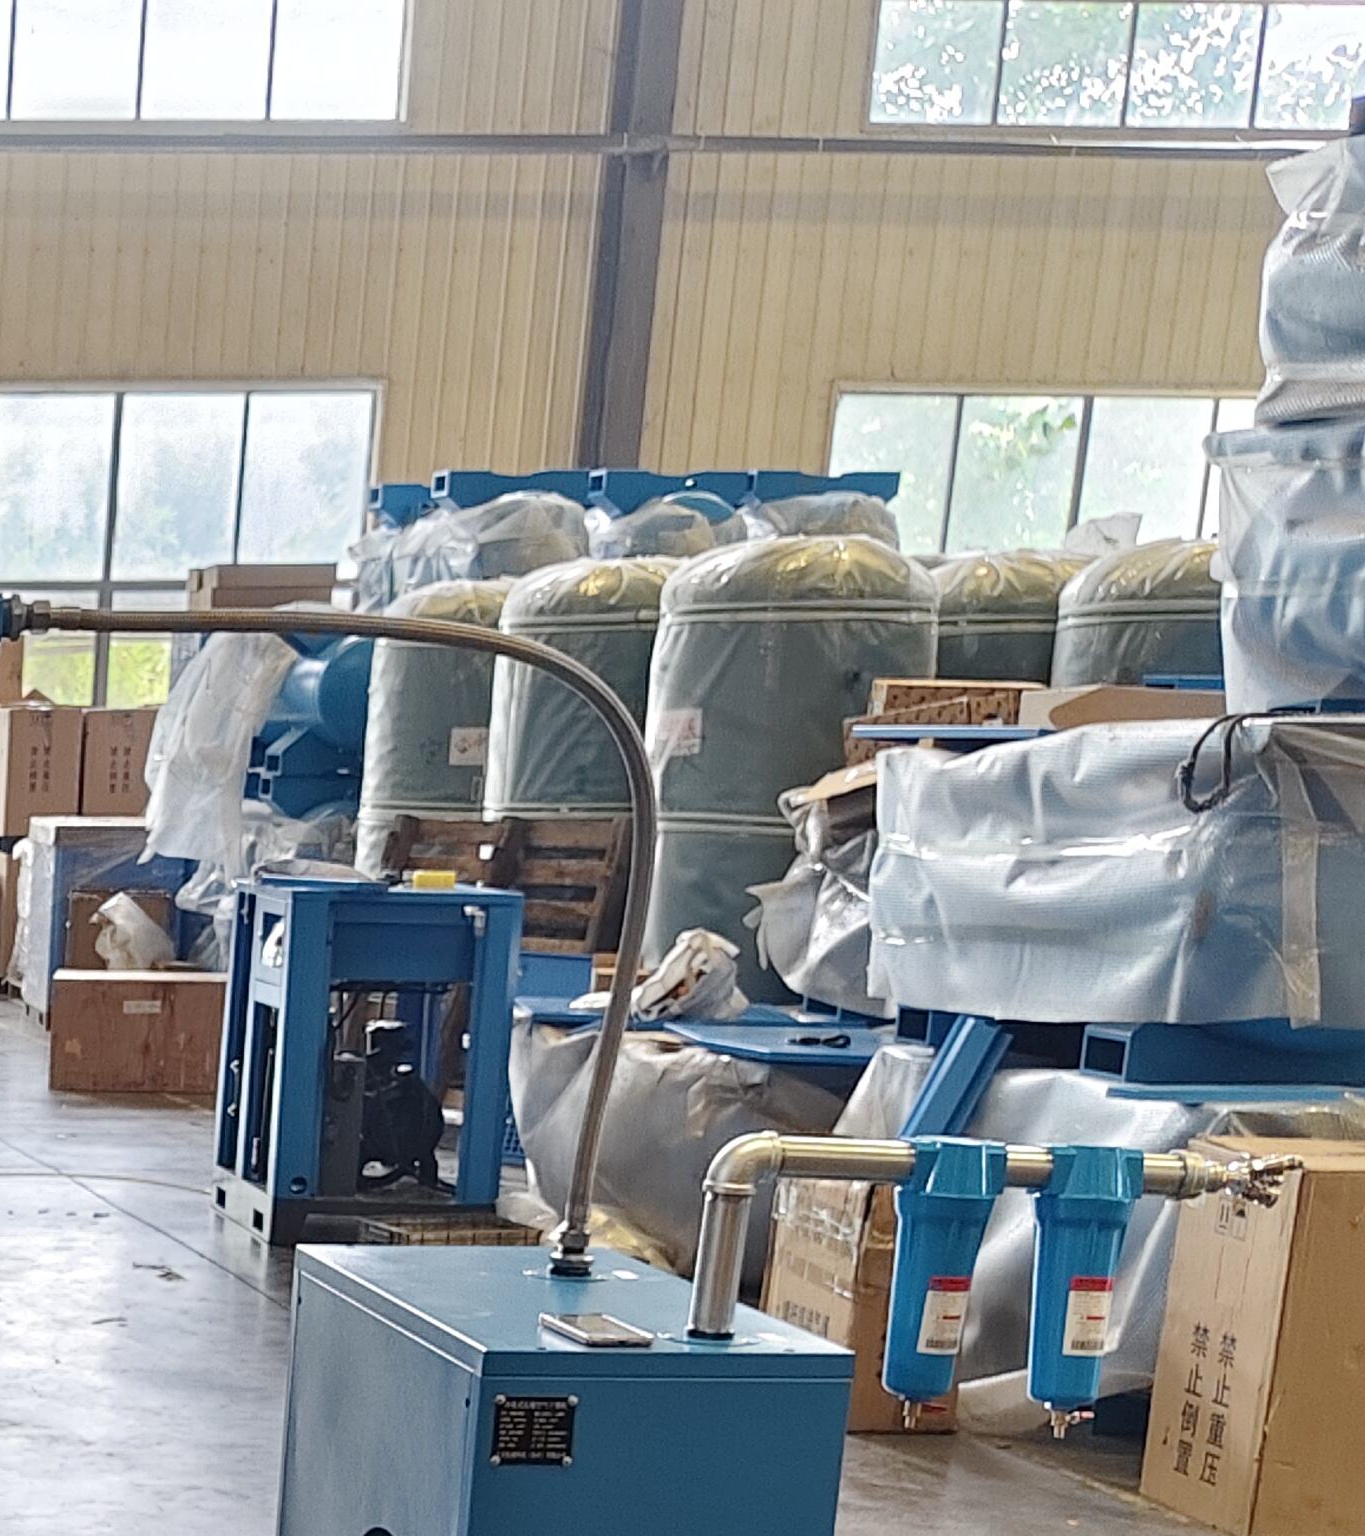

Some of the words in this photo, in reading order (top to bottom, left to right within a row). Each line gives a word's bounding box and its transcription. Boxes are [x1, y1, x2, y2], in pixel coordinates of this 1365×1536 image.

[1173, 1321, 1210, 1477] 禁止倒置
[1199, 1330, 1237, 1486] 禁止重压
